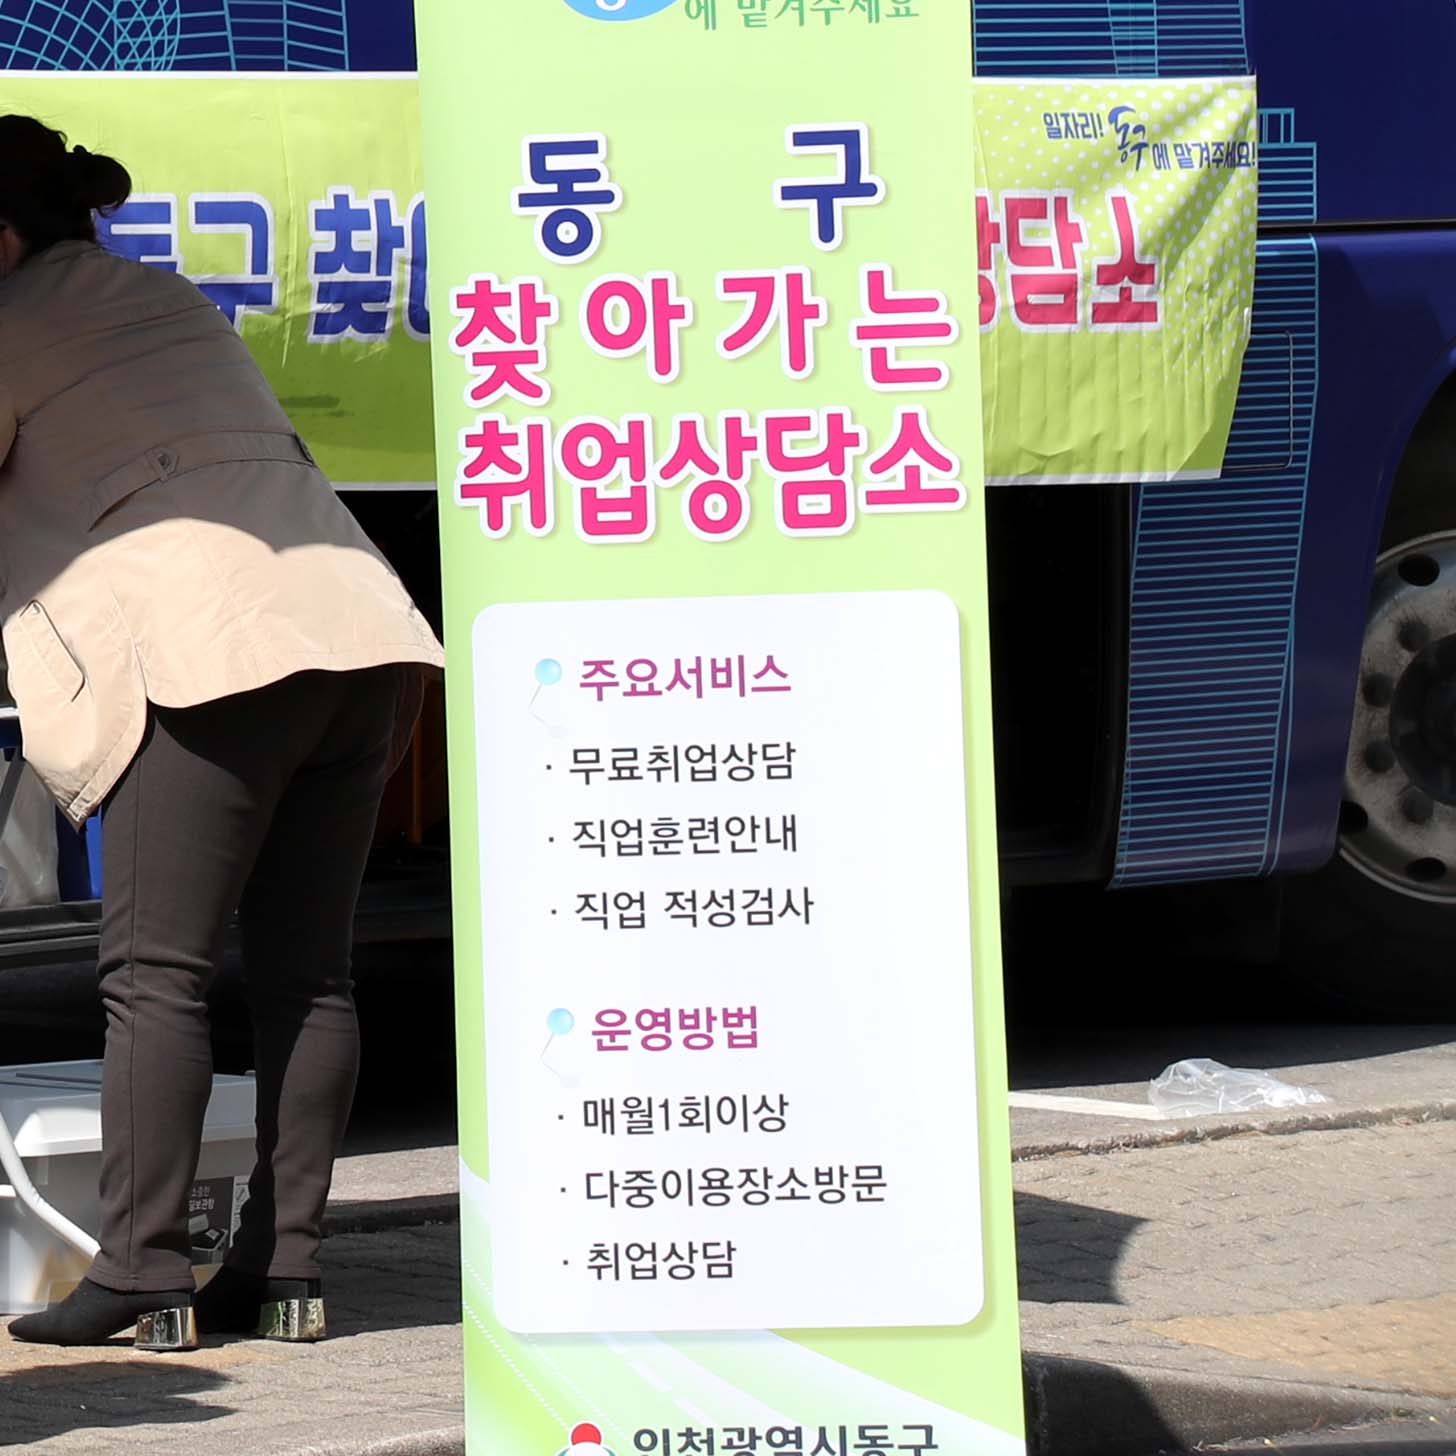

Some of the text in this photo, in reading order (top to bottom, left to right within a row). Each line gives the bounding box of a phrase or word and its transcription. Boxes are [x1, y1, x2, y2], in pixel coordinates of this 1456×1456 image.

[1043, 111, 1105, 140] 일자리!
[460, 411, 961, 537] 취업상담소
[579, 654, 792, 701] 주요서비스
[568, 741, 797, 786] 무료취업상담
[572, 814, 798, 858] 직업훈련안내
[574, 886, 815, 930] 직업 적성검사
[591, 1006, 759, 1053] 운영방법
[583, 1093, 790, 1136] 매월1회이상
[585, 1165, 888, 1209] 다중이용장소방문
[586, 1239, 738, 1282] 취업상담
